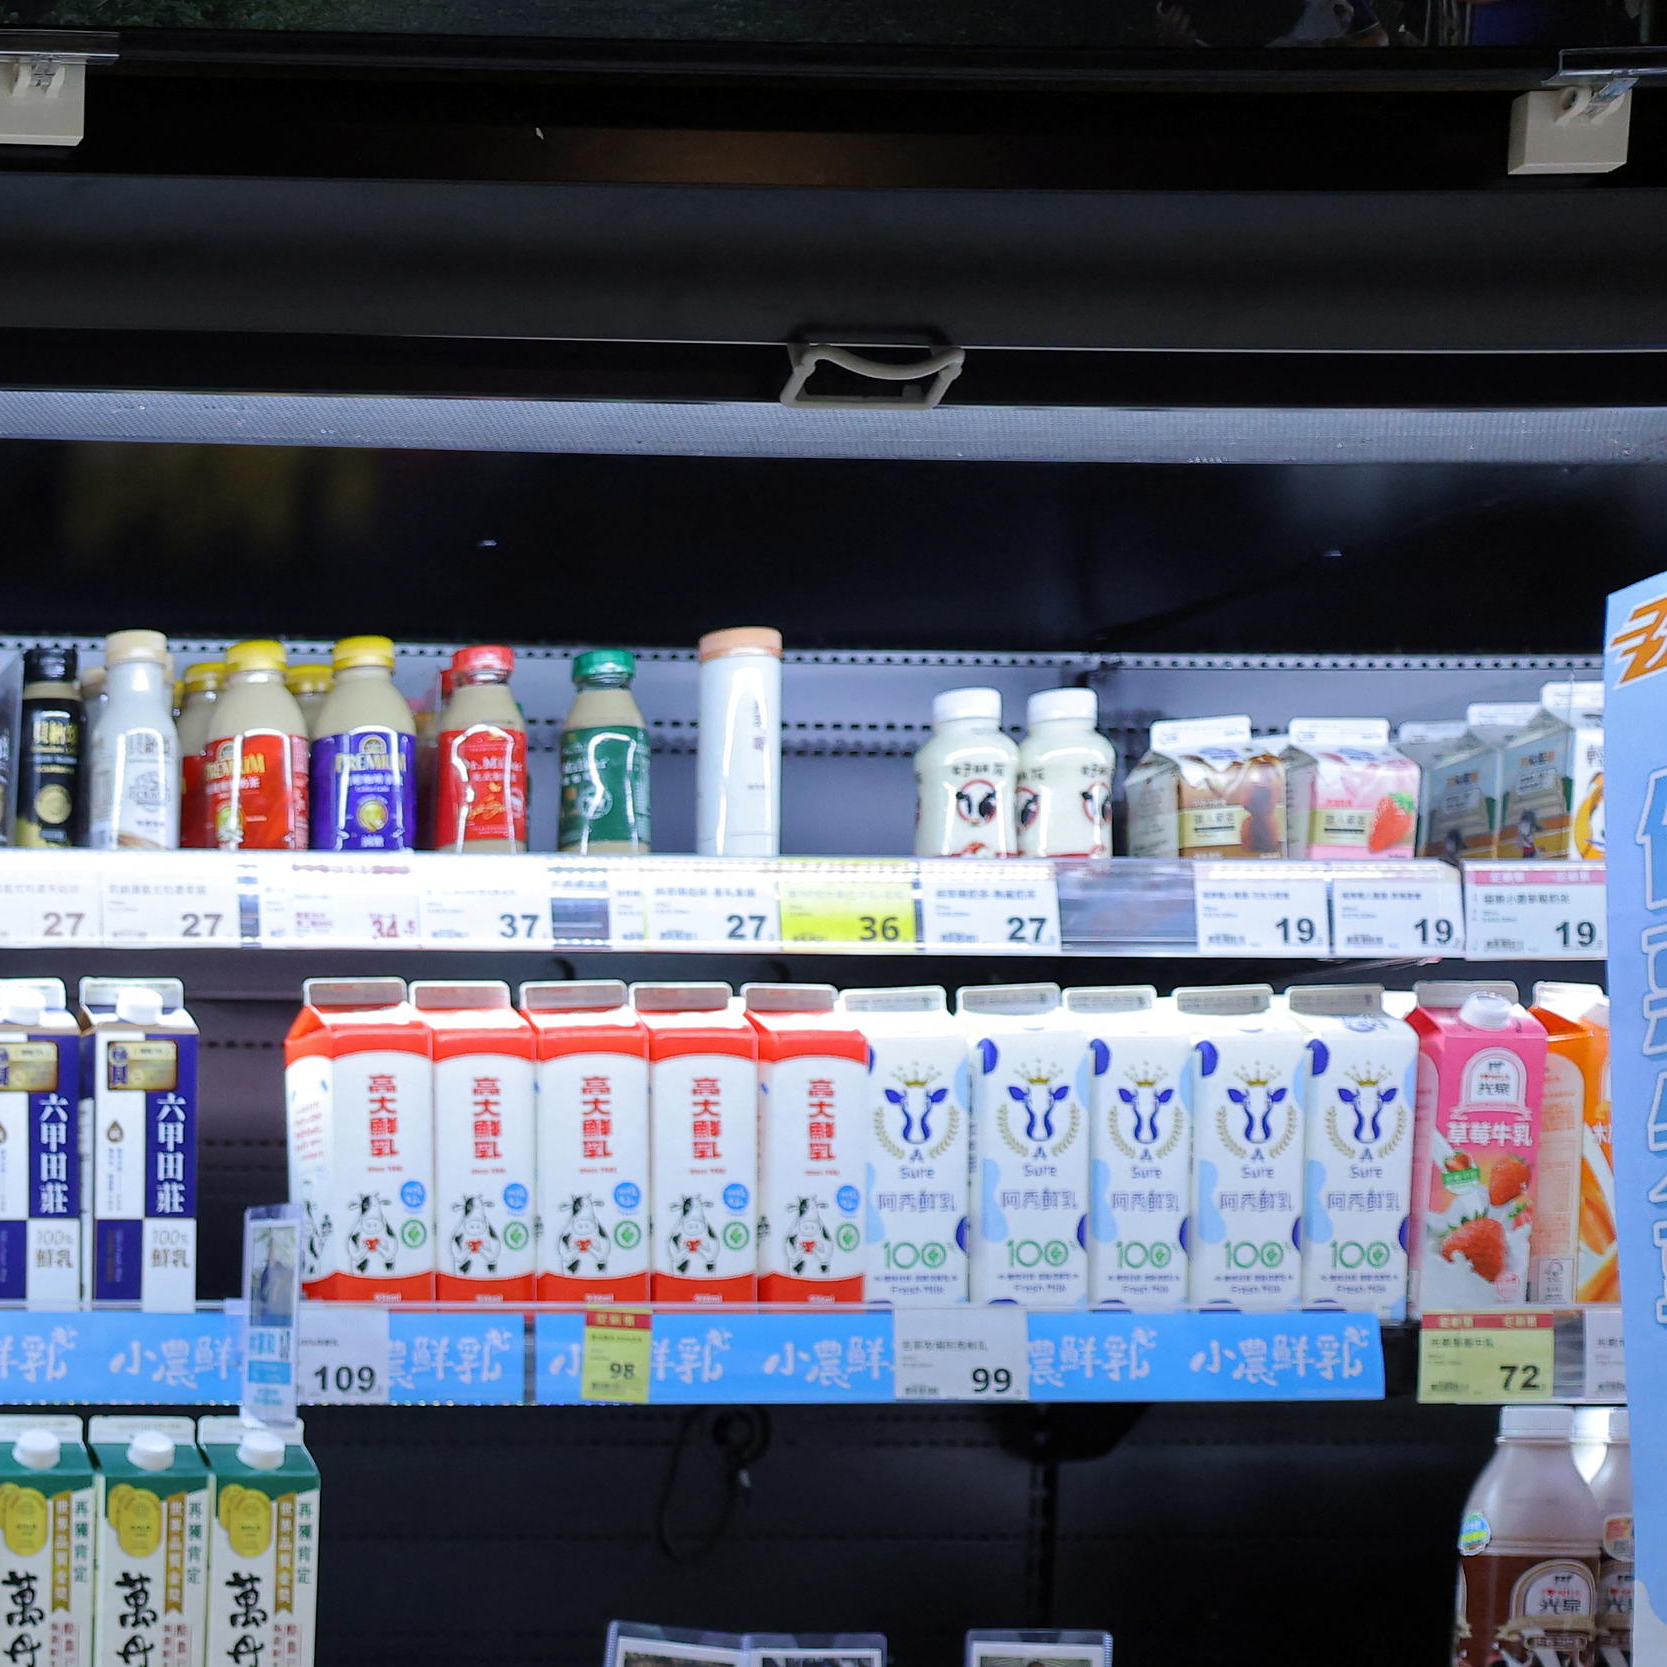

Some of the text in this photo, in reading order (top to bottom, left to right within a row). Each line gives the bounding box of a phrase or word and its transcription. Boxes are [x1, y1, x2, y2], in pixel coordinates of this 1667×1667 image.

[43, 913, 86, 936] 27
[181, 914, 223, 936] 27
[499, 915, 538, 938] 37
[727, 916, 766, 939] 27
[858, 917, 898, 940] 36
[1007, 918, 1046, 942] 27
[1275, 919, 1315, 944] 19
[1413, 919, 1453, 944] 19
[1555, 922, 1596, 948] 19
[1446, 1121, 1532, 1147] 草莓牛乳
[314, 1366, 376, 1392] 109
[610, 1361, 635, 1379] 98
[971, 1368, 1012, 1394] 99
[1500, 1365, 1539, 1390] 72
